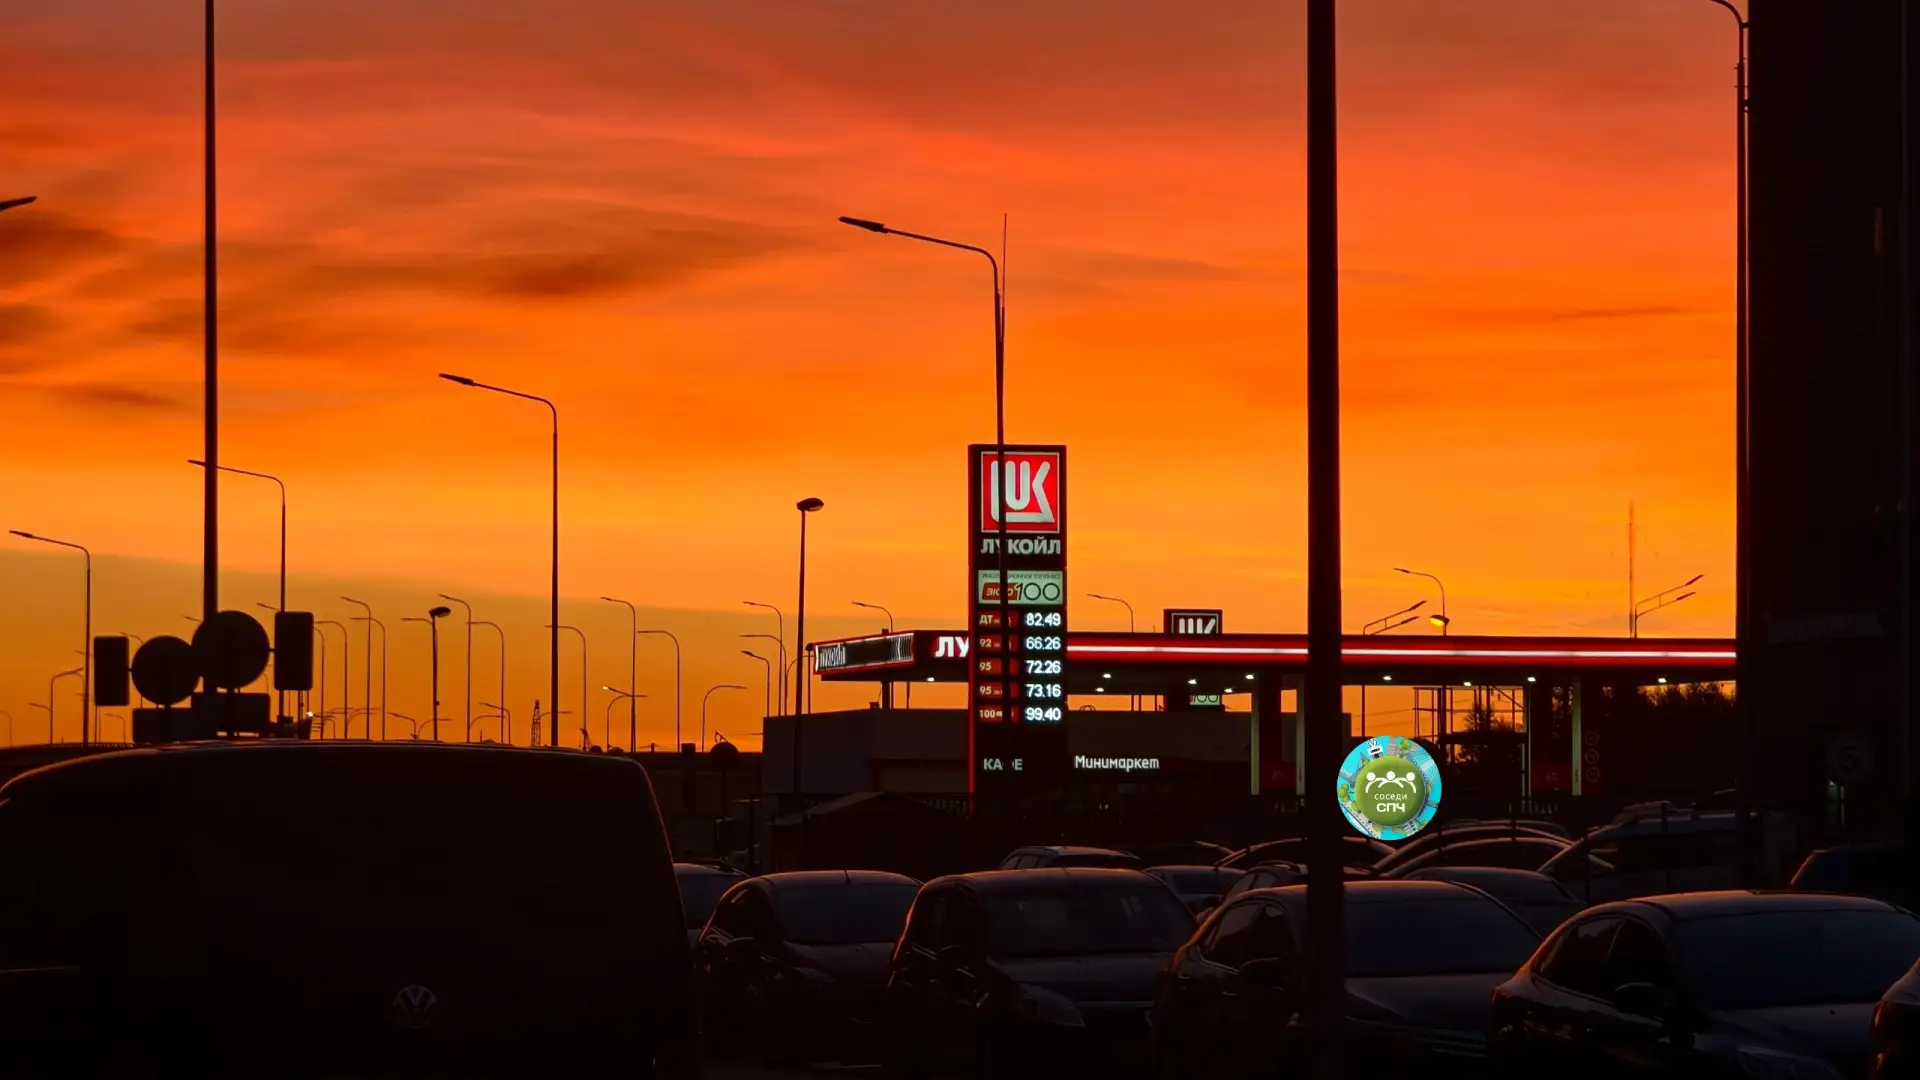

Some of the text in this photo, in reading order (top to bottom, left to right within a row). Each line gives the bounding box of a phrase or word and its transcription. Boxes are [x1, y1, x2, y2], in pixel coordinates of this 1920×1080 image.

[986, 582, 1061, 602] ЭКО 100
[979, 614, 993, 626] ДТ
[1025, 612, 1062, 627] 82.49
[980, 638, 992, 648] 92
[1025, 636, 1062, 651] 66.26
[980, 659, 1062, 674] 95 72.26
[980, 685, 992, 695] 95
[1025, 683, 1062, 698] 73.16
[979, 709, 996, 719] 100
[1025, 706, 1062, 721] 99.40
[983, 757, 1024, 771] КАЕ
[1074, 755, 1160, 772] Минимаркет
